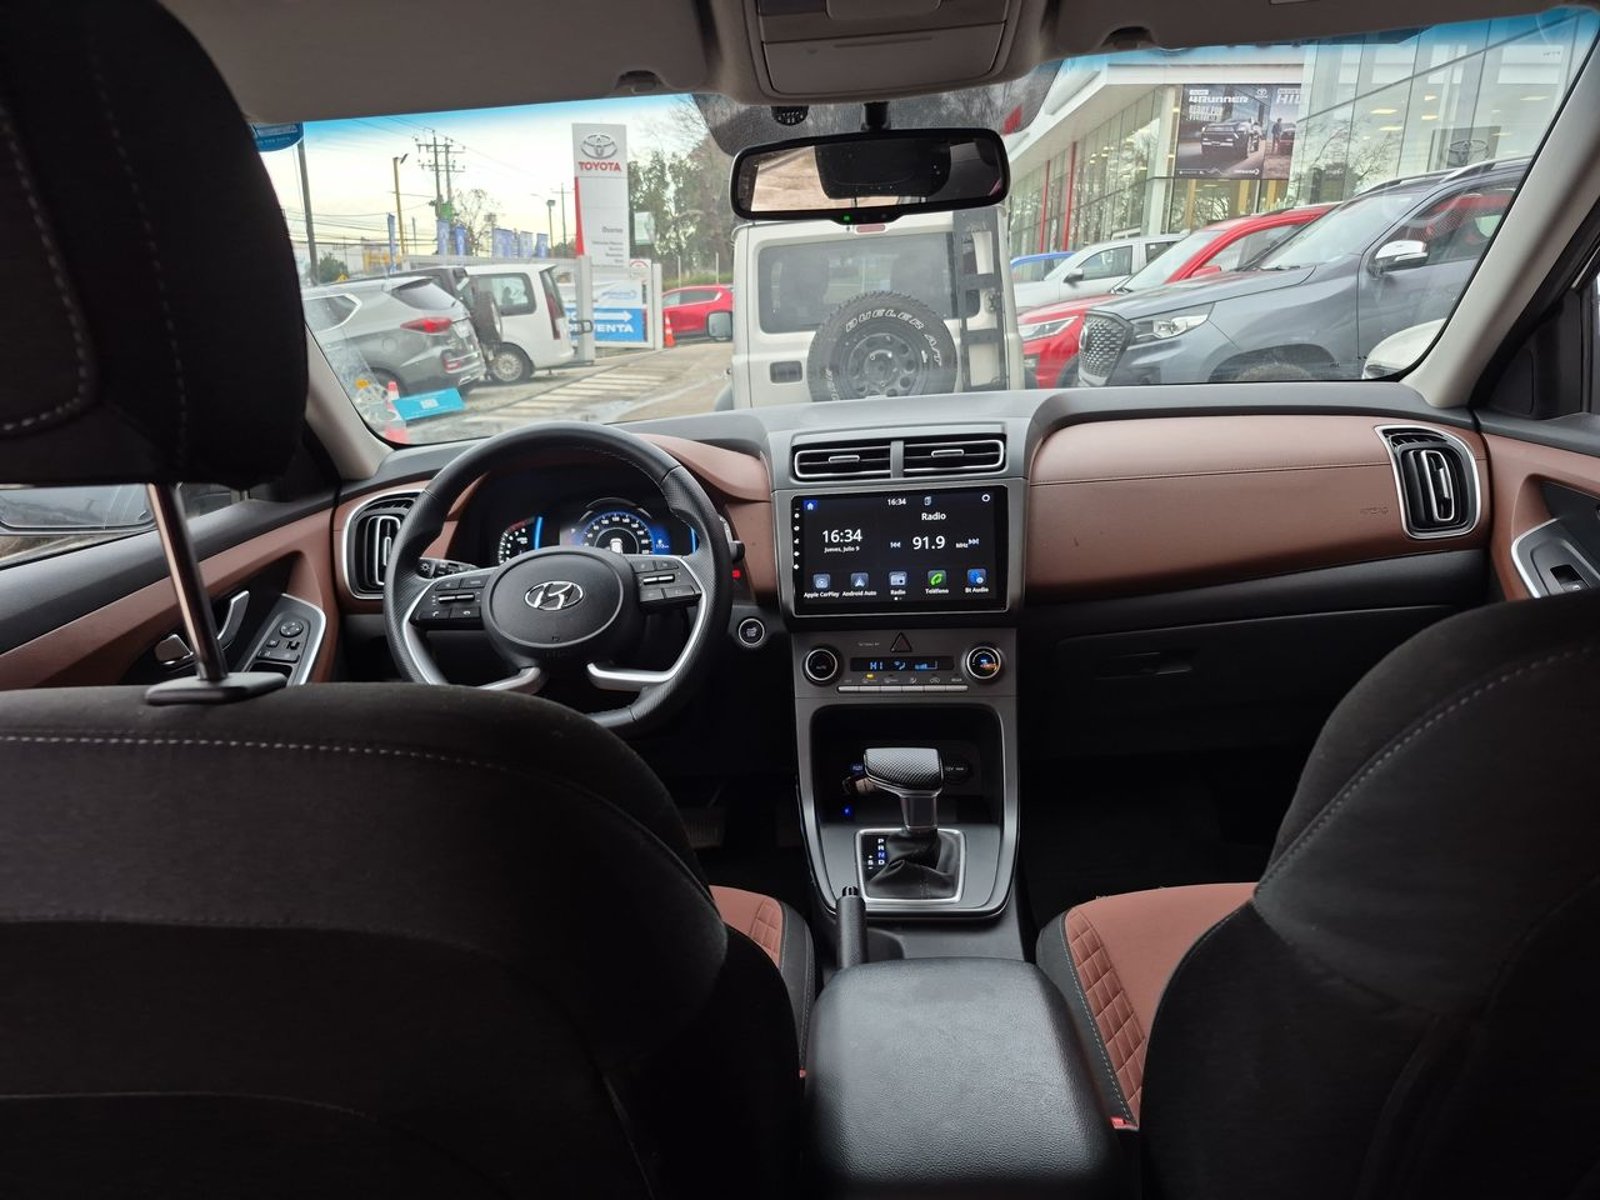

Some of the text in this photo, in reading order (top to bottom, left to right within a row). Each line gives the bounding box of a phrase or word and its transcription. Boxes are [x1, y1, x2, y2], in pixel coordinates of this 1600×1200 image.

[578, 161, 622, 172] TOYOTA
[845, 308, 925, 333] DUELER
[887, 497, 907, 506] 16:34
[921, 512, 947, 521] Radio
[822, 528, 863, 543] 16:34
[912, 535, 946, 550] 91.9
[804, 590, 840, 599] Apple CarPlay
[973, 586, 989, 594] Audio
